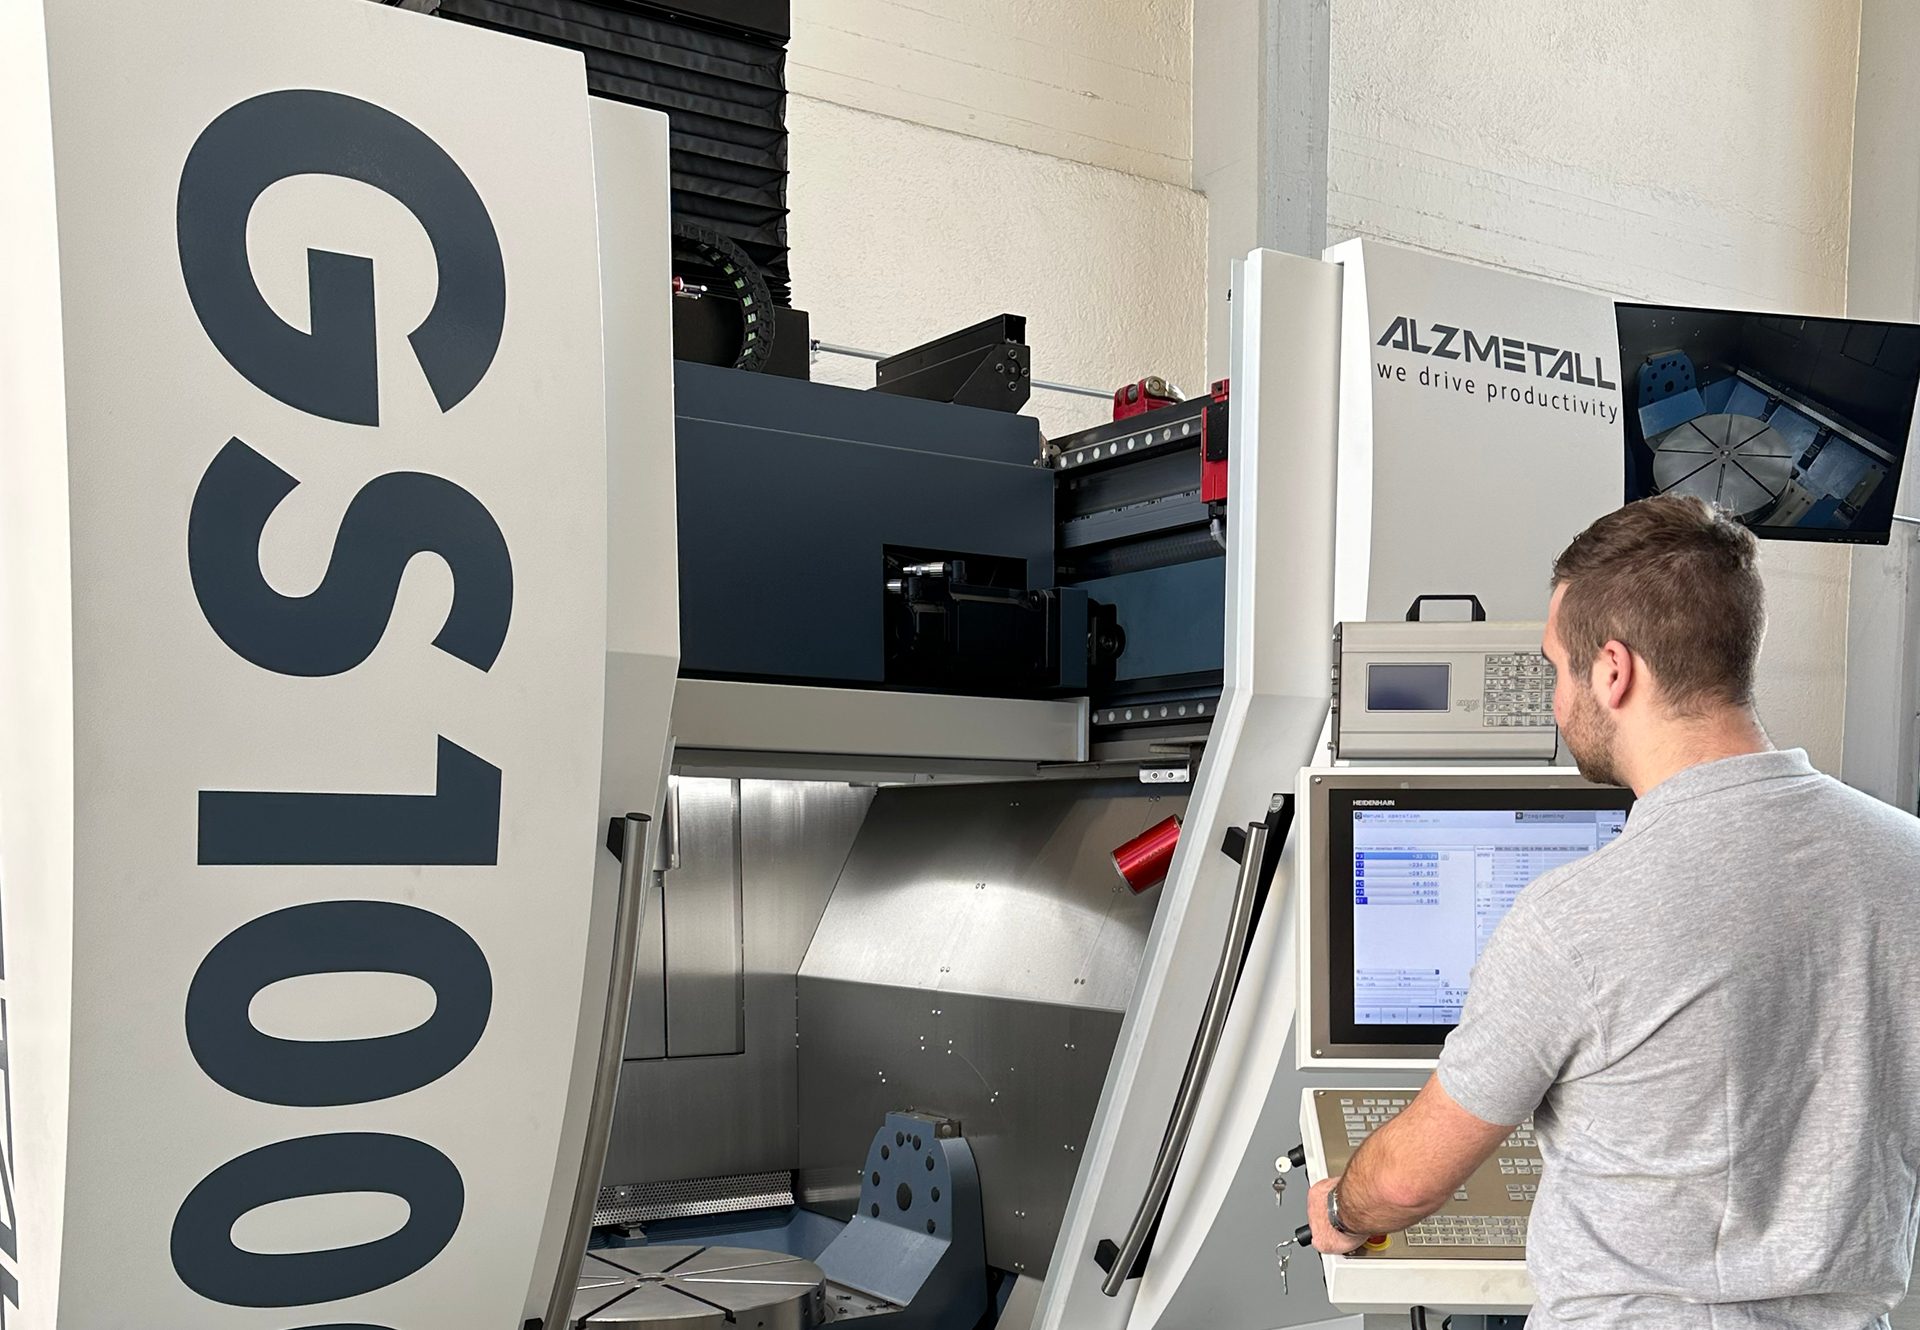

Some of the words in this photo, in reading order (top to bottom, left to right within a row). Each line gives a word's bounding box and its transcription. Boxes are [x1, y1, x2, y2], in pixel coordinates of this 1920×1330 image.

[1377, 315, 1617, 391] ALZMETALL
[1377, 362, 1407, 382] we
[1419, 365, 1475, 395] drive
[1487, 383, 1618, 425] productivity
[176, 88, 514, 1330] GS100
[1352, 799, 1396, 807] HEIDENHAIN
